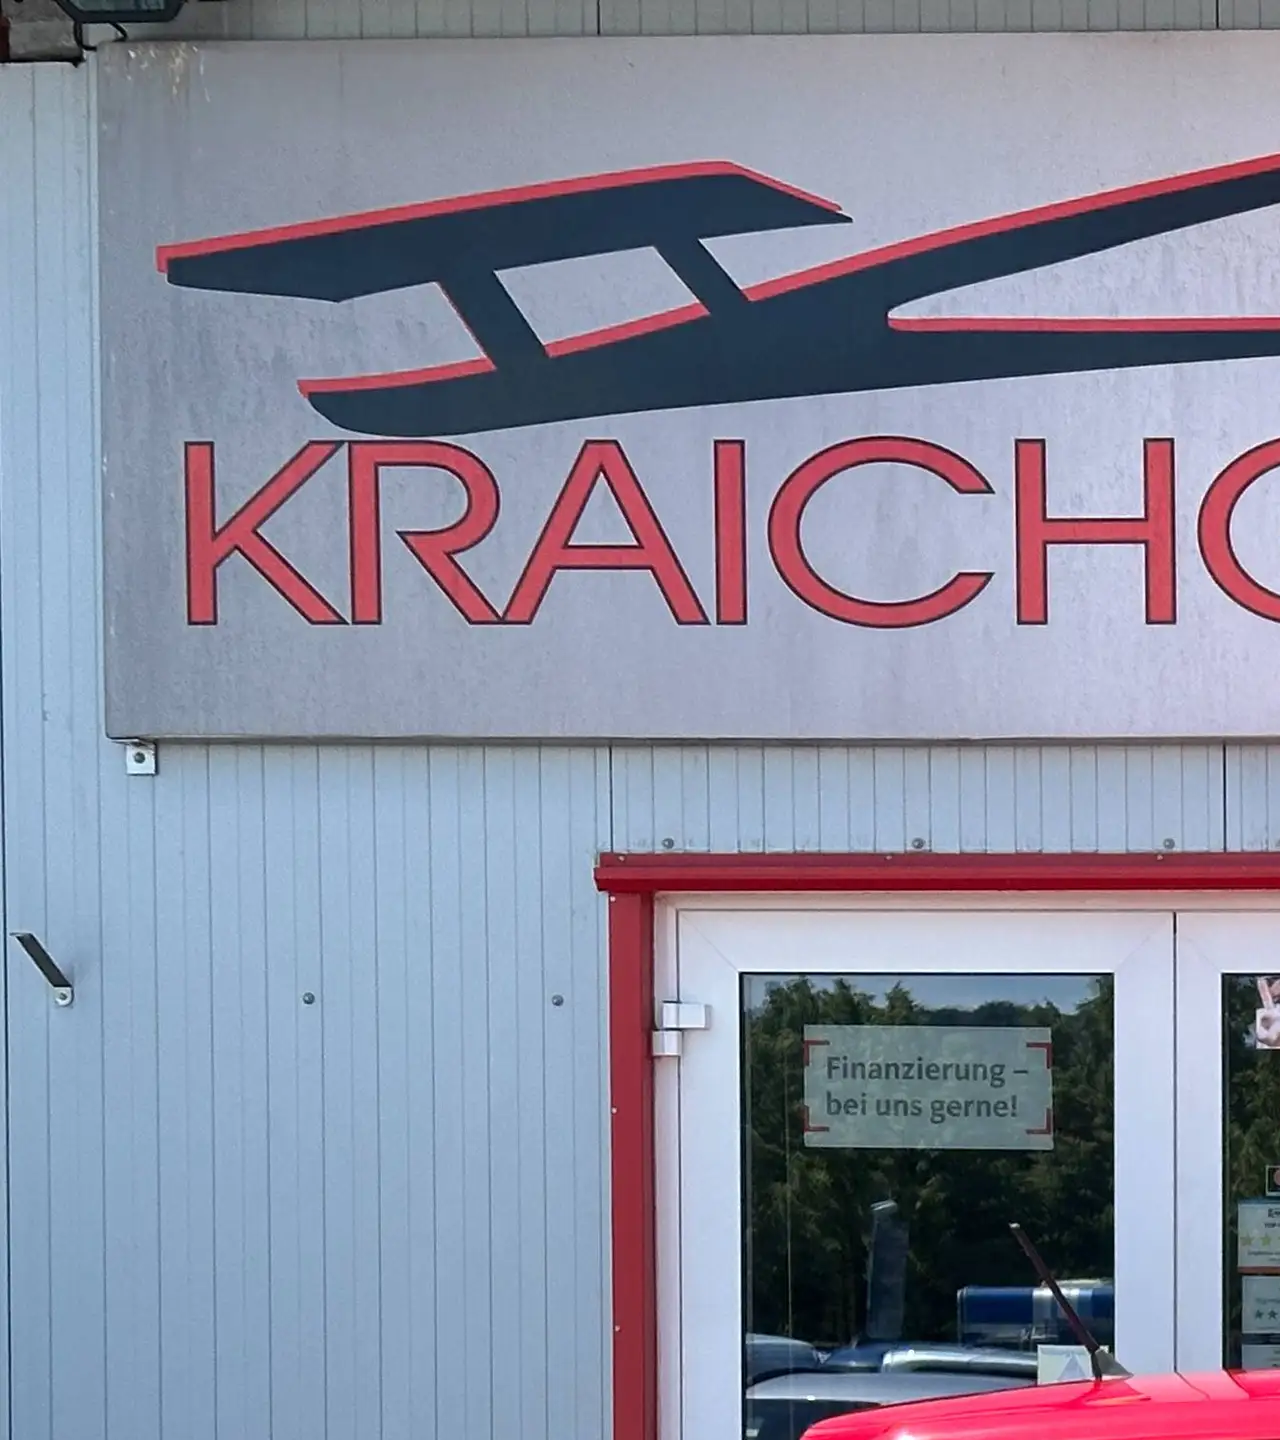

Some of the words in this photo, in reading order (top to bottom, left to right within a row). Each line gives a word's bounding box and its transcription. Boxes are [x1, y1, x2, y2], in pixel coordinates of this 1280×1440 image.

[825, 1056, 1005, 1087] Finanzierung
[826, 1091, 867, 1117] bei
[876, 1098, 922, 1117] uns
[929, 1093, 1018, 1124] gerne!
